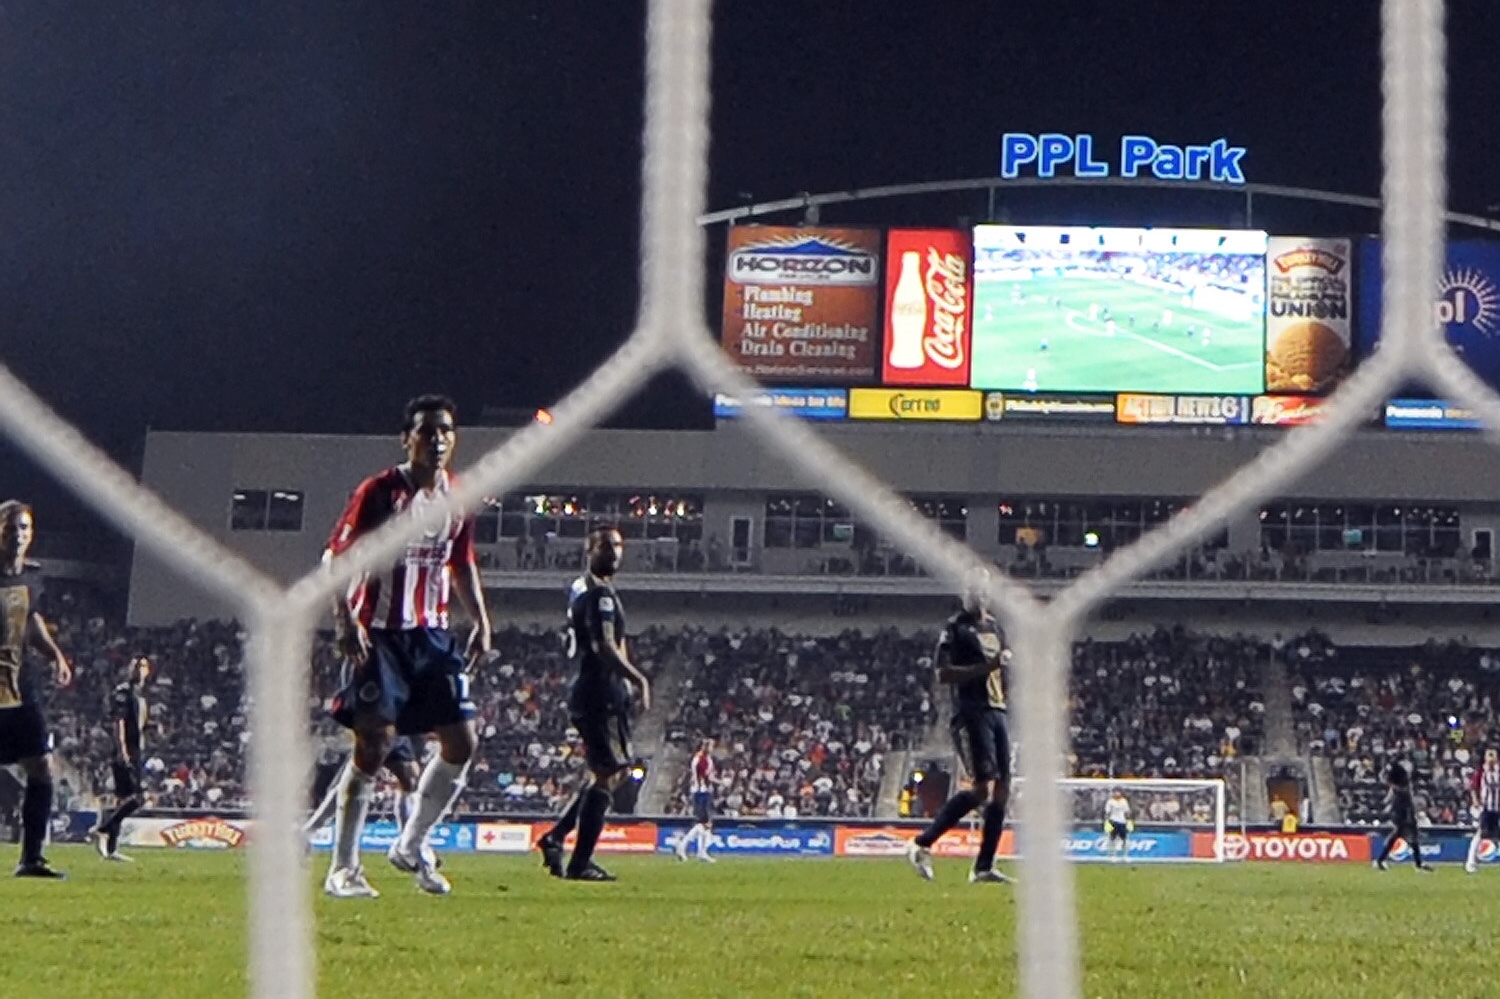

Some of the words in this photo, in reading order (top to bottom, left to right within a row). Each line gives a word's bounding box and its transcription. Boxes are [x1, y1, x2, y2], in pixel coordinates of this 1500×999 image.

[1002, 133, 1109, 179] PPL
[1121, 135, 1247, 184] Park
[737, 256, 873, 274] HORIZON
[744, 285, 813, 306] Plumbing
[743, 304, 802, 322] Heating
[924, 245, 966, 369] Coca-Cola
[1271, 301, 1347, 320] UNION
[1432, 290, 1466, 331] pl
[742, 322, 768, 338] Air
[772, 322, 868, 342] Conditioning
[741, 339, 784, 356] Drain
[789, 340, 857, 360] Cleaning
[1252, 836, 1348, 859] TOYOTA
